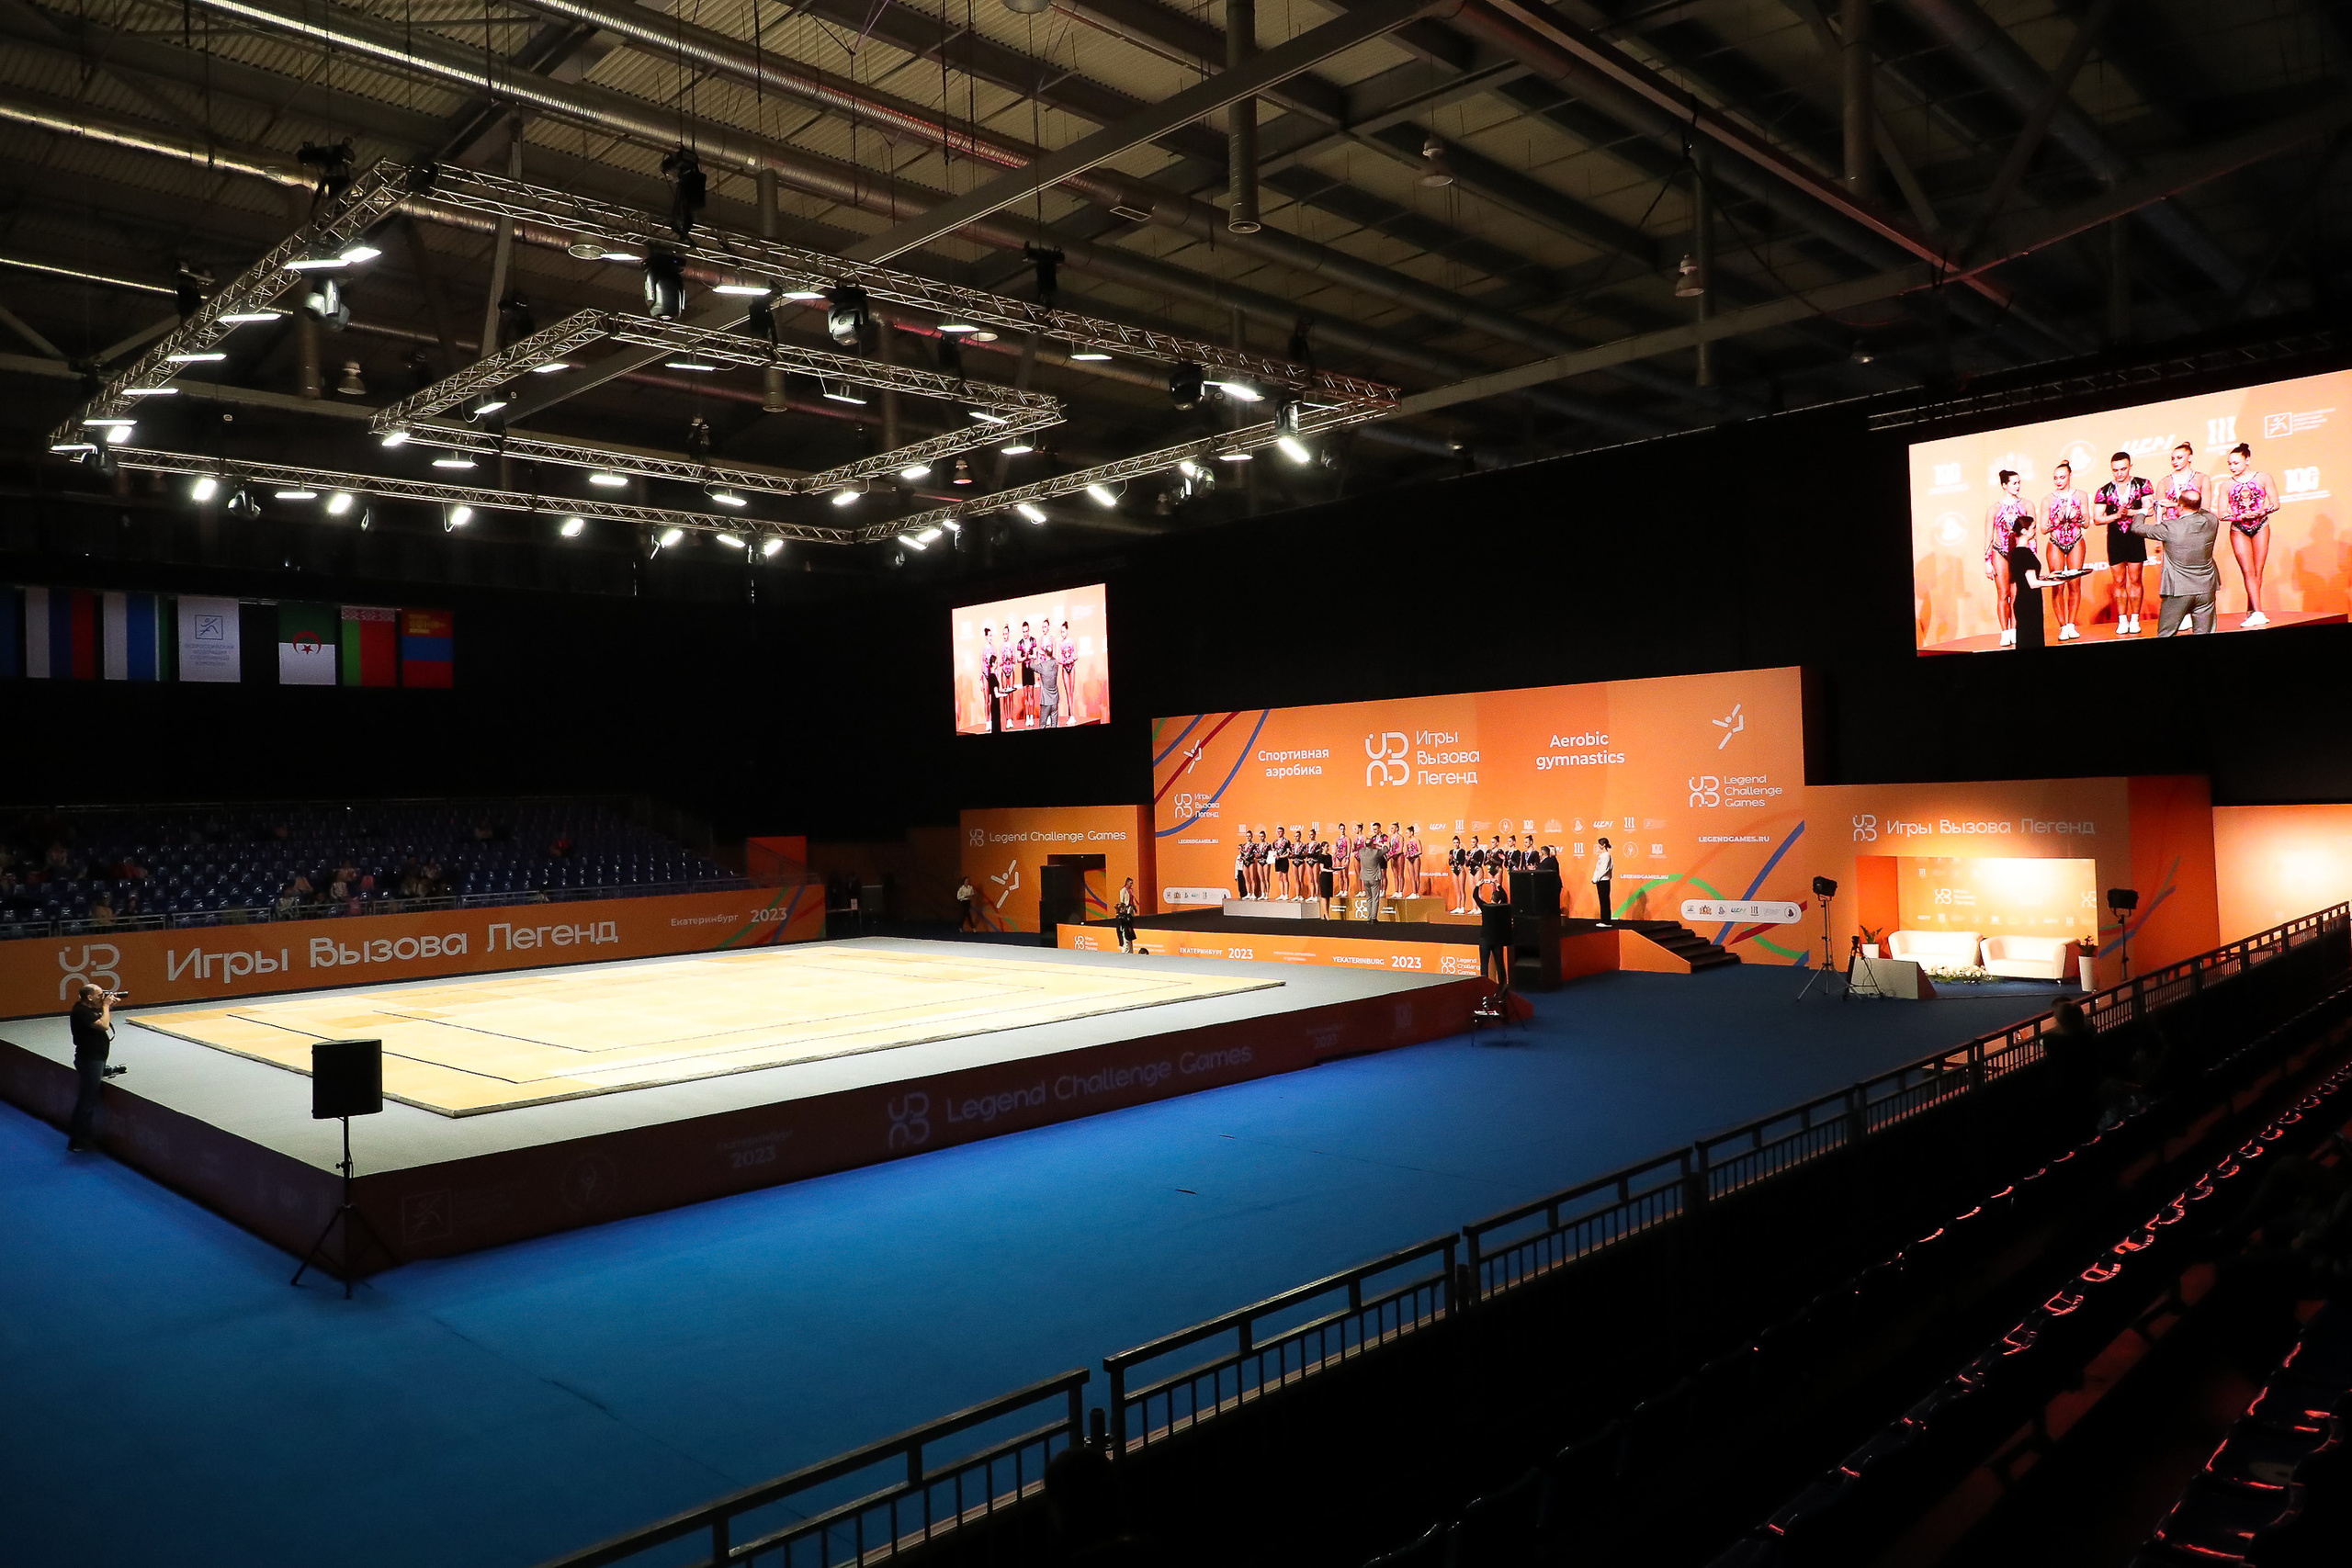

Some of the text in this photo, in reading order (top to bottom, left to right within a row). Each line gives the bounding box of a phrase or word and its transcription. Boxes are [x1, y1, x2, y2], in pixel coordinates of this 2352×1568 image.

[1416, 729, 1459, 748] Игры
[1549, 730, 1610, 749] Aerobic
[1258, 749, 1329, 763] Спортивная
[1417, 750, 1480, 765] Вызова
[1535, 750, 1625, 770] gymnastics
[1265, 763, 1322, 779] аэробика
[1418, 770, 1478, 785] Легенд
[1724, 774, 1767, 786] Legend
[1724, 786, 1783, 797] Challenge
[1724, 797, 1766, 807] Games
[1886, 818, 2096, 838] Игры Вызова Легенд
[989, 829, 1126, 844] Legend Challenge Games
[670, 907, 788, 928] Екатеринбург 2023
[166, 920, 618, 984] Игры Вызова Легенд
[1179, 946, 1254, 960] ЕКАТЕРИНБУРГ 2023
[1332, 954, 1423, 969] YEKATERINBURG 2023
[946, 1045, 1253, 1122] Legend Challenge Games
[731, 1145, 776, 1168] 2023
